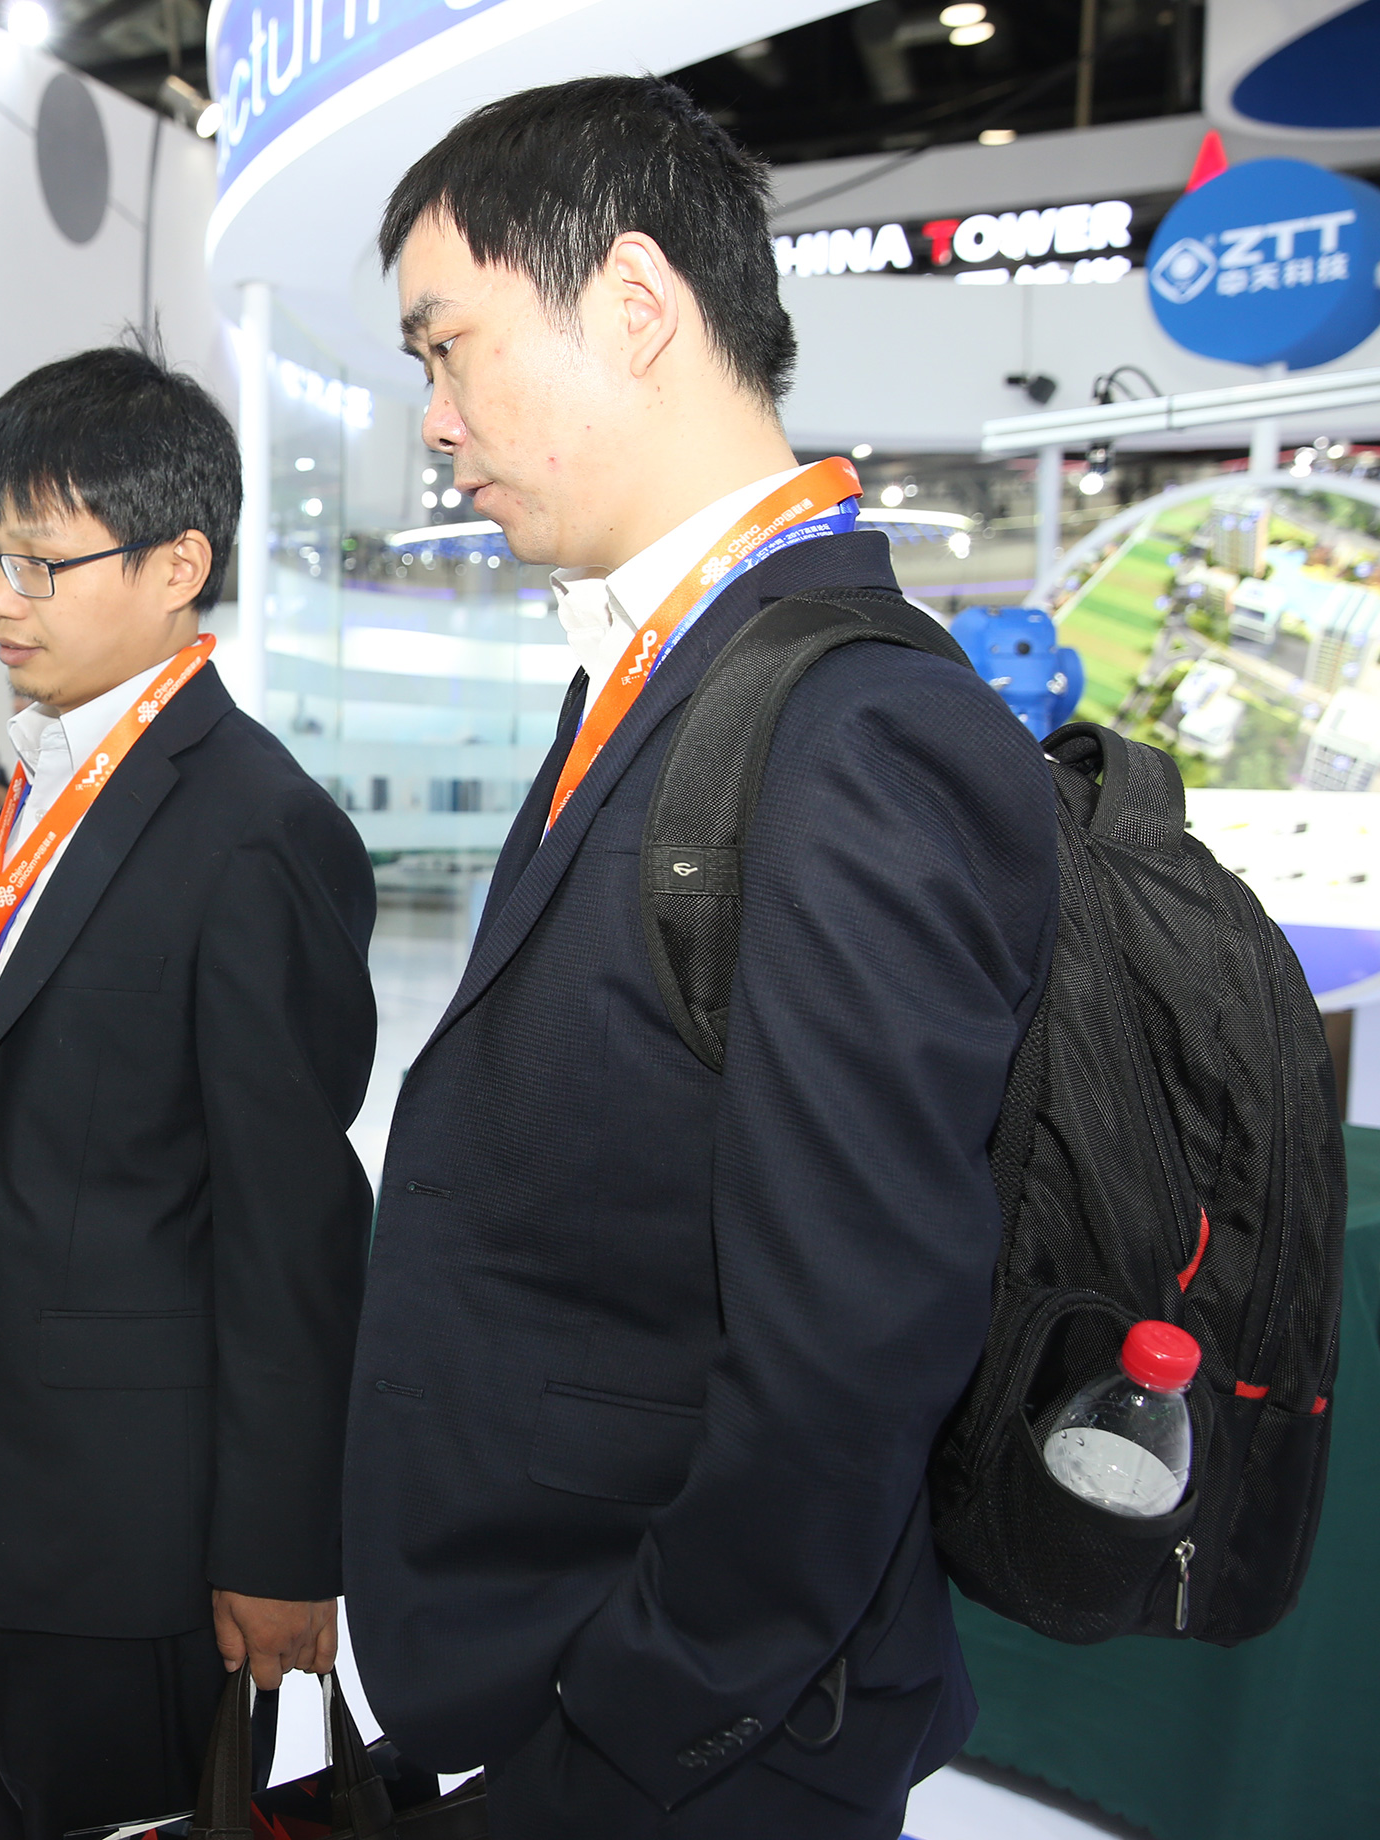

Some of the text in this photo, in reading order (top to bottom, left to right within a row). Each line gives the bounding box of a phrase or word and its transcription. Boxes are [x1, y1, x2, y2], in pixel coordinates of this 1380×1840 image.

[774, 223, 913, 278] HINA
[922, 200, 1134, 267] TOWER
[1220, 208, 1357, 269] ZTT
[1215, 251, 1349, 297] 中天科技
